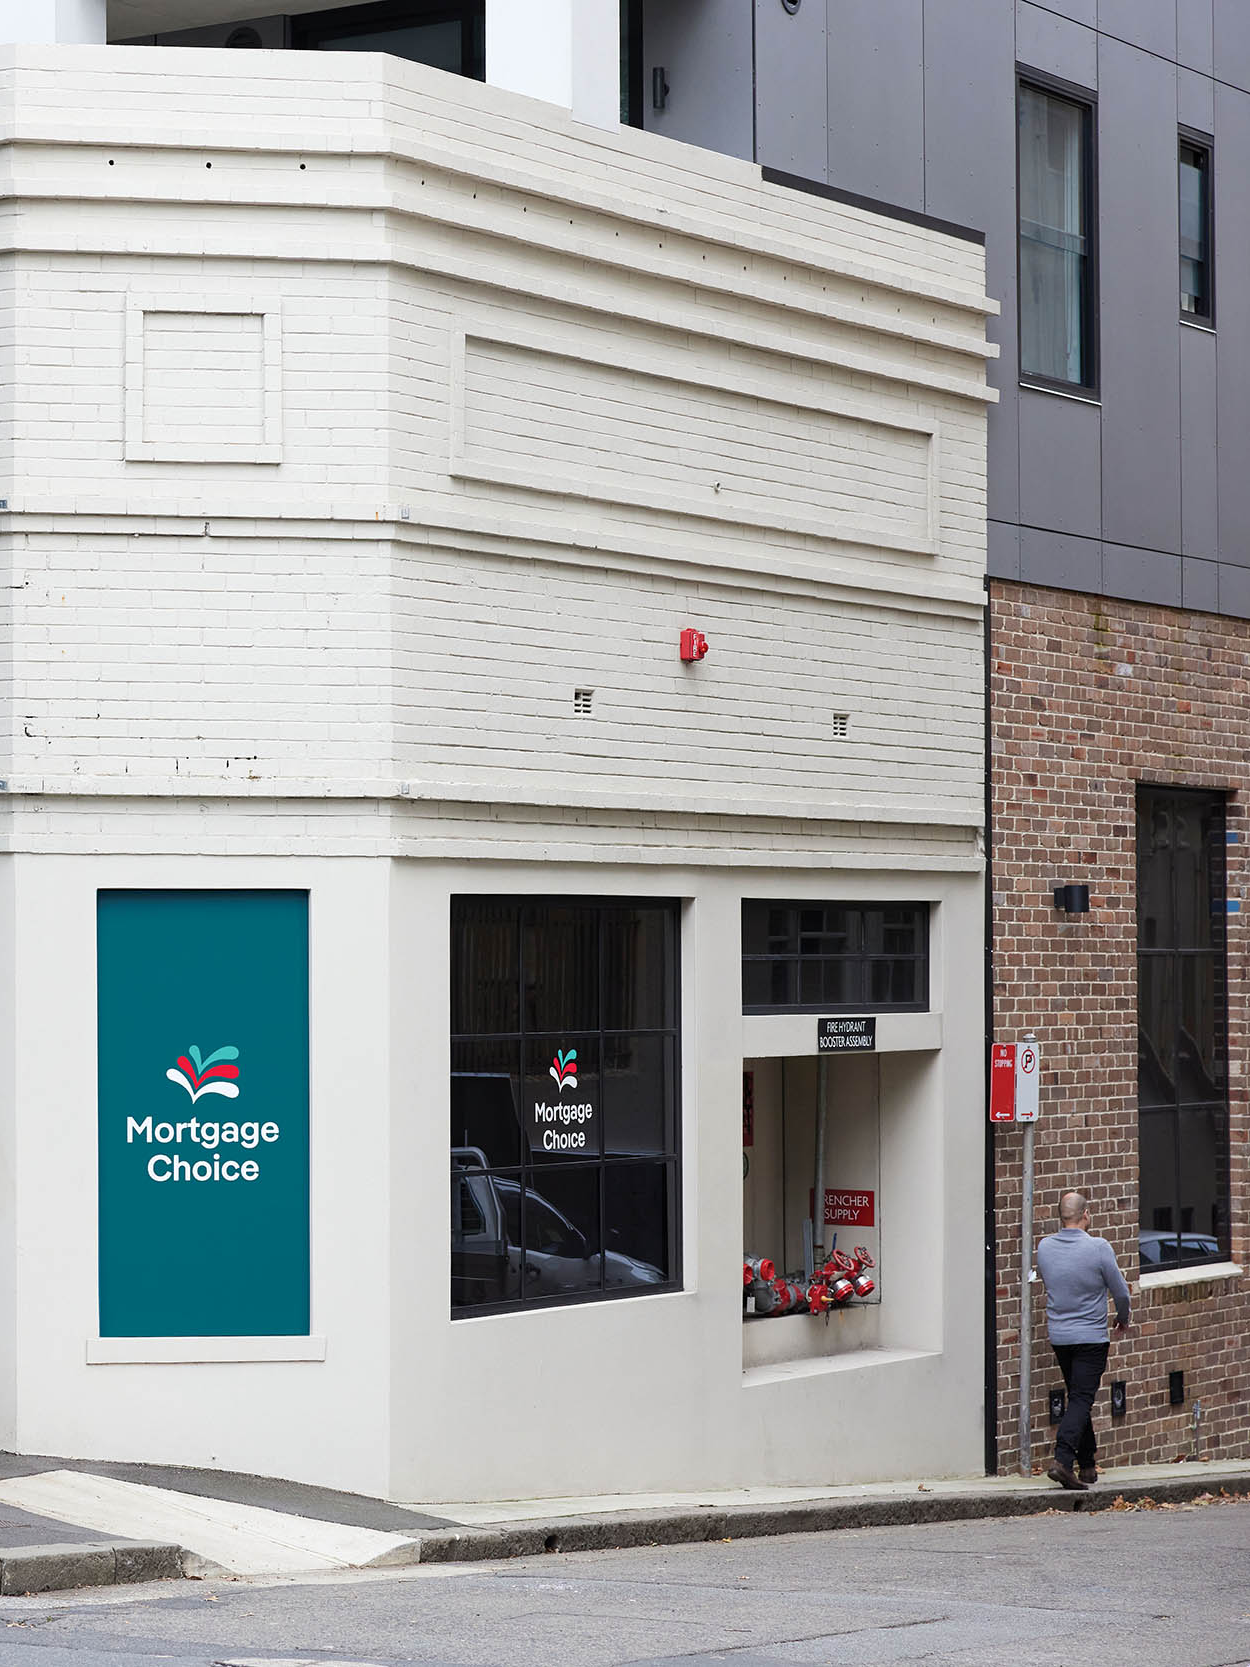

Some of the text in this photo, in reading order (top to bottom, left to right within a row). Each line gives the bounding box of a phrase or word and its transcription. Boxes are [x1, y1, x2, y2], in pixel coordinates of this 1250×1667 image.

[827, 1021, 866, 1032] FIRE HYDRANT
[819, 1035, 872, 1048] BOOSTER ASSEMBLY
[534, 1101, 593, 1125] Mortgage
[126, 1116, 280, 1149] Mortgage
[543, 1130, 586, 1150] Choice
[148, 1153, 259, 1182] Choice
[824, 1208, 860, 1221] SUPPLY
